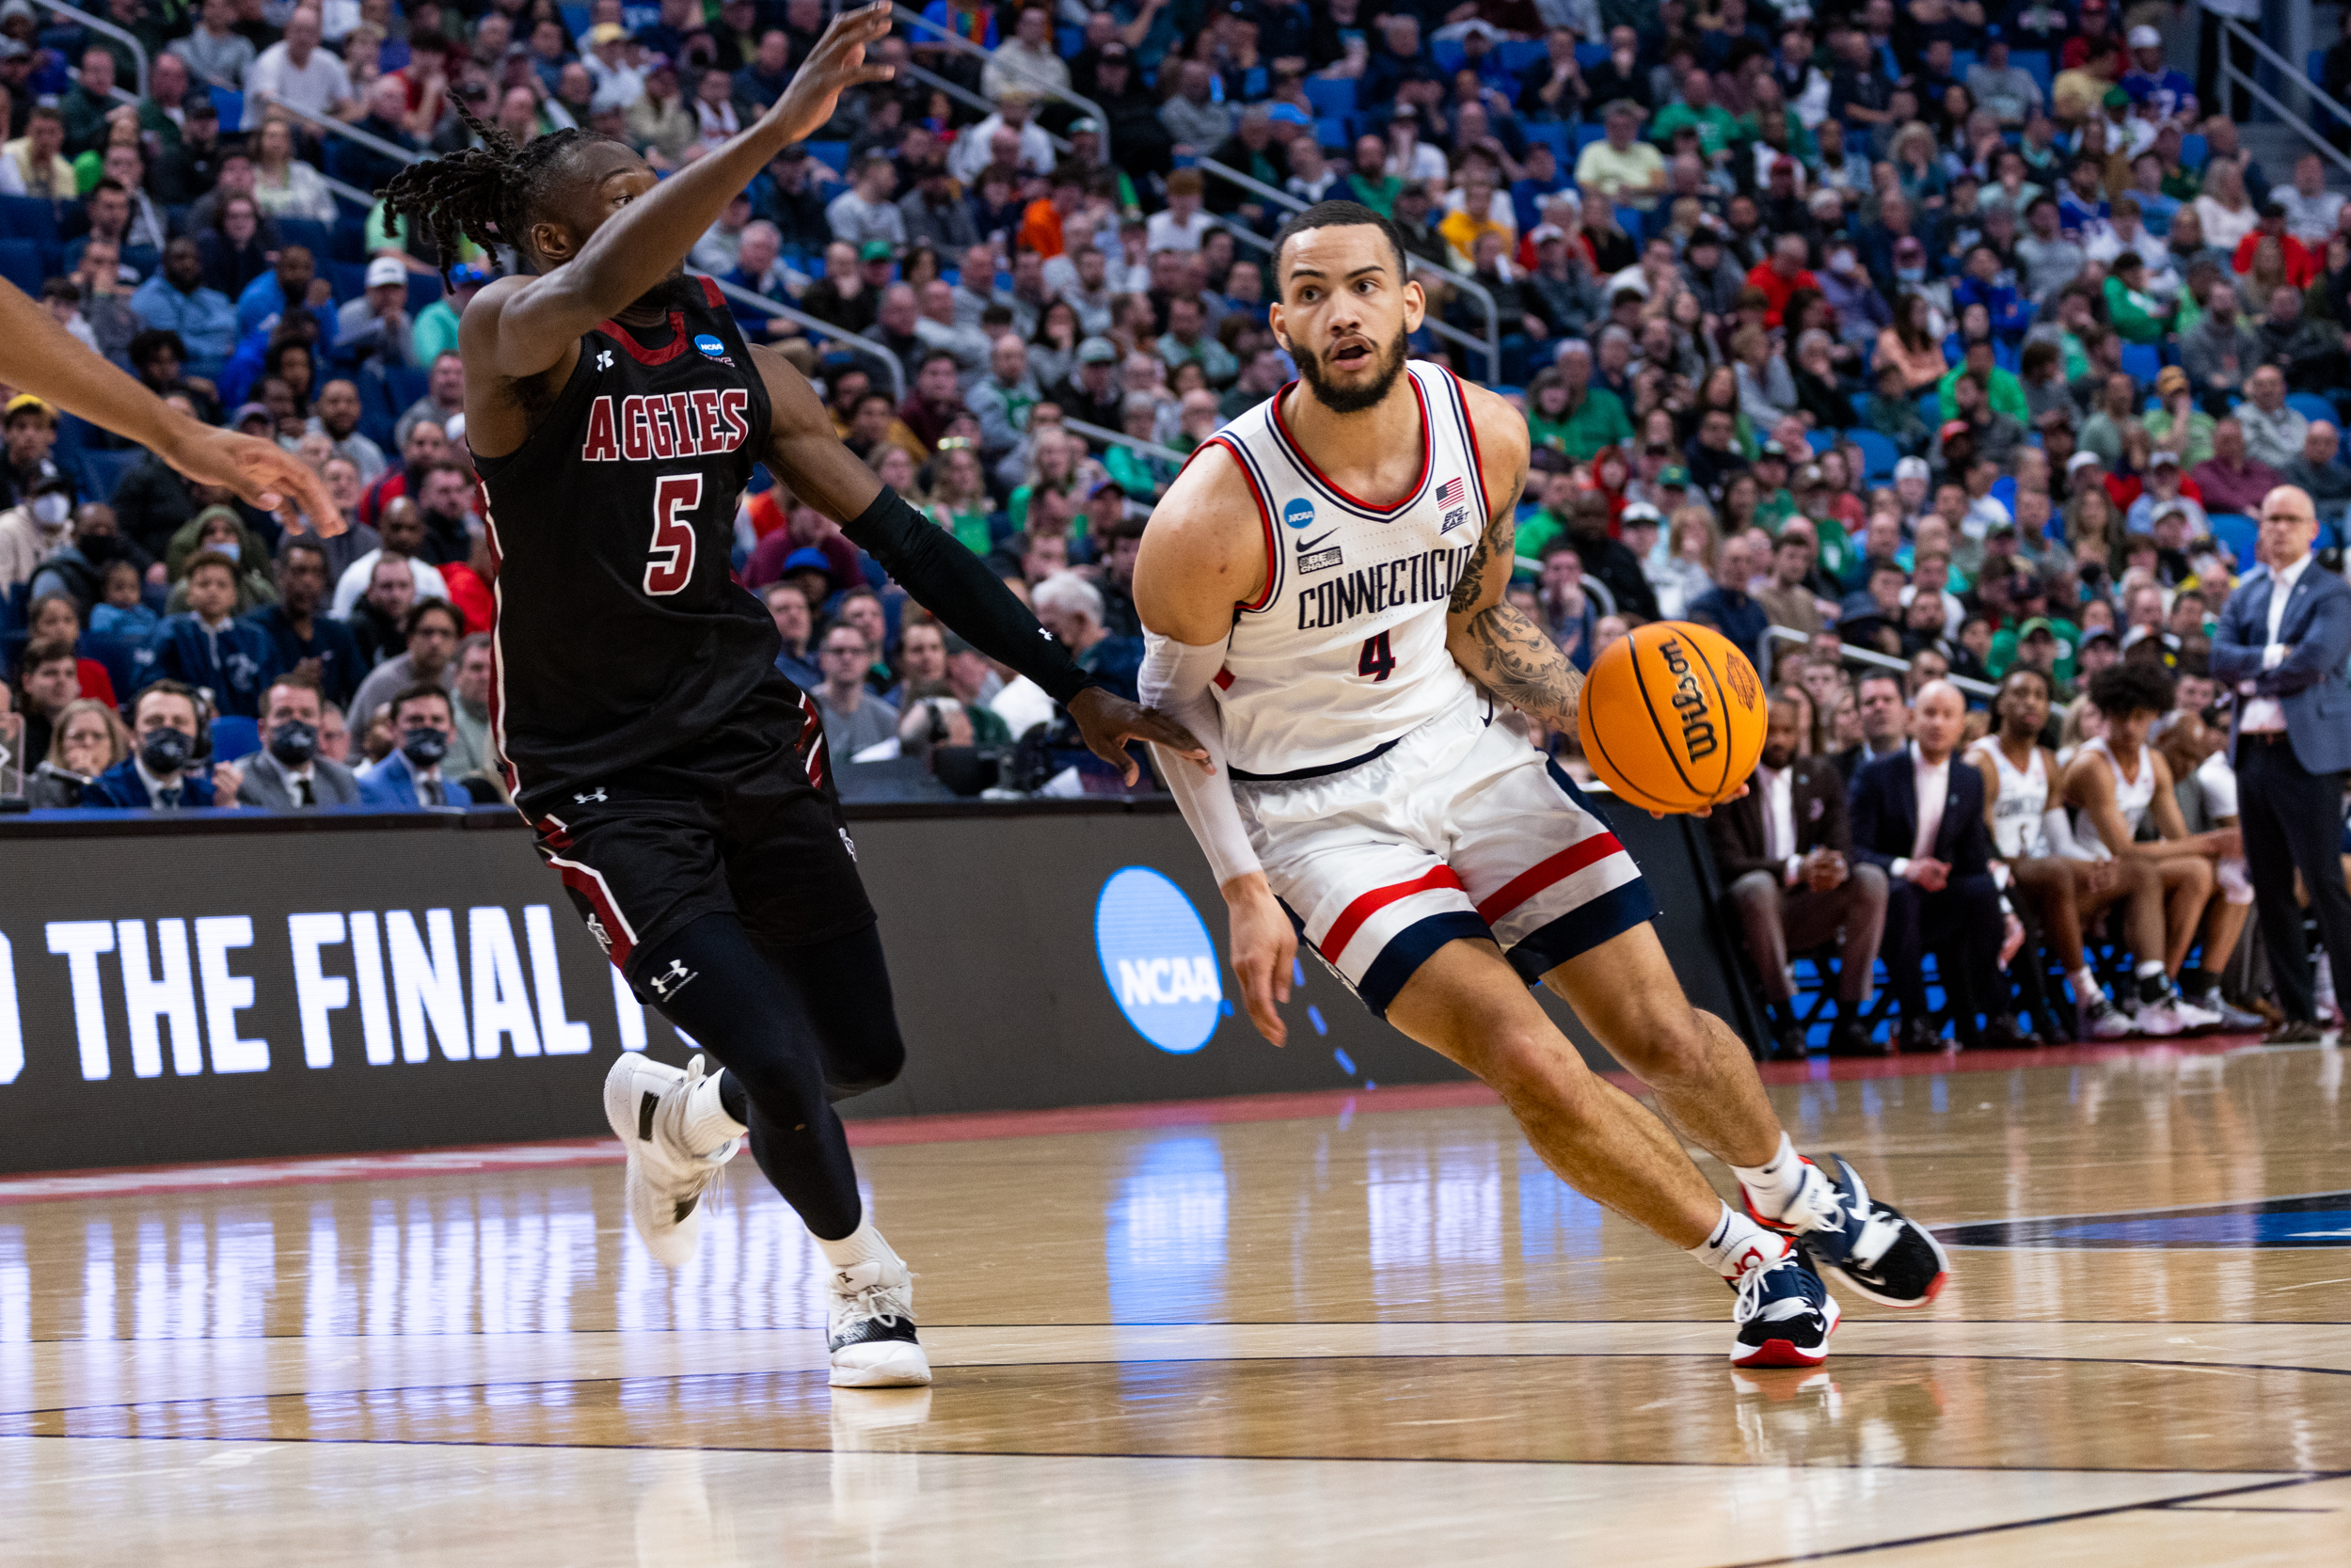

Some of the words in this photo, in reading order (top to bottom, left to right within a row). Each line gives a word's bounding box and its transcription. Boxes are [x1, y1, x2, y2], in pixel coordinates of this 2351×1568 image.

[700, 342, 723, 351] NCAA
[581, 388, 749, 461] AGGIES
[643, 472, 703, 595] 5
[1288, 511, 1314, 523] NCAA
[1441, 511, 1469, 531] EAST
[1444, 506, 1465, 523] BIG
[1300, 557, 1342, 573] CHANGE
[1358, 629, 1396, 682] 4
[1658, 637, 1718, 765] Wilson
[45, 915, 271, 1081] THE
[287, 904, 593, 1069] FINAL
[1117, 956, 1223, 1006] NCAA
